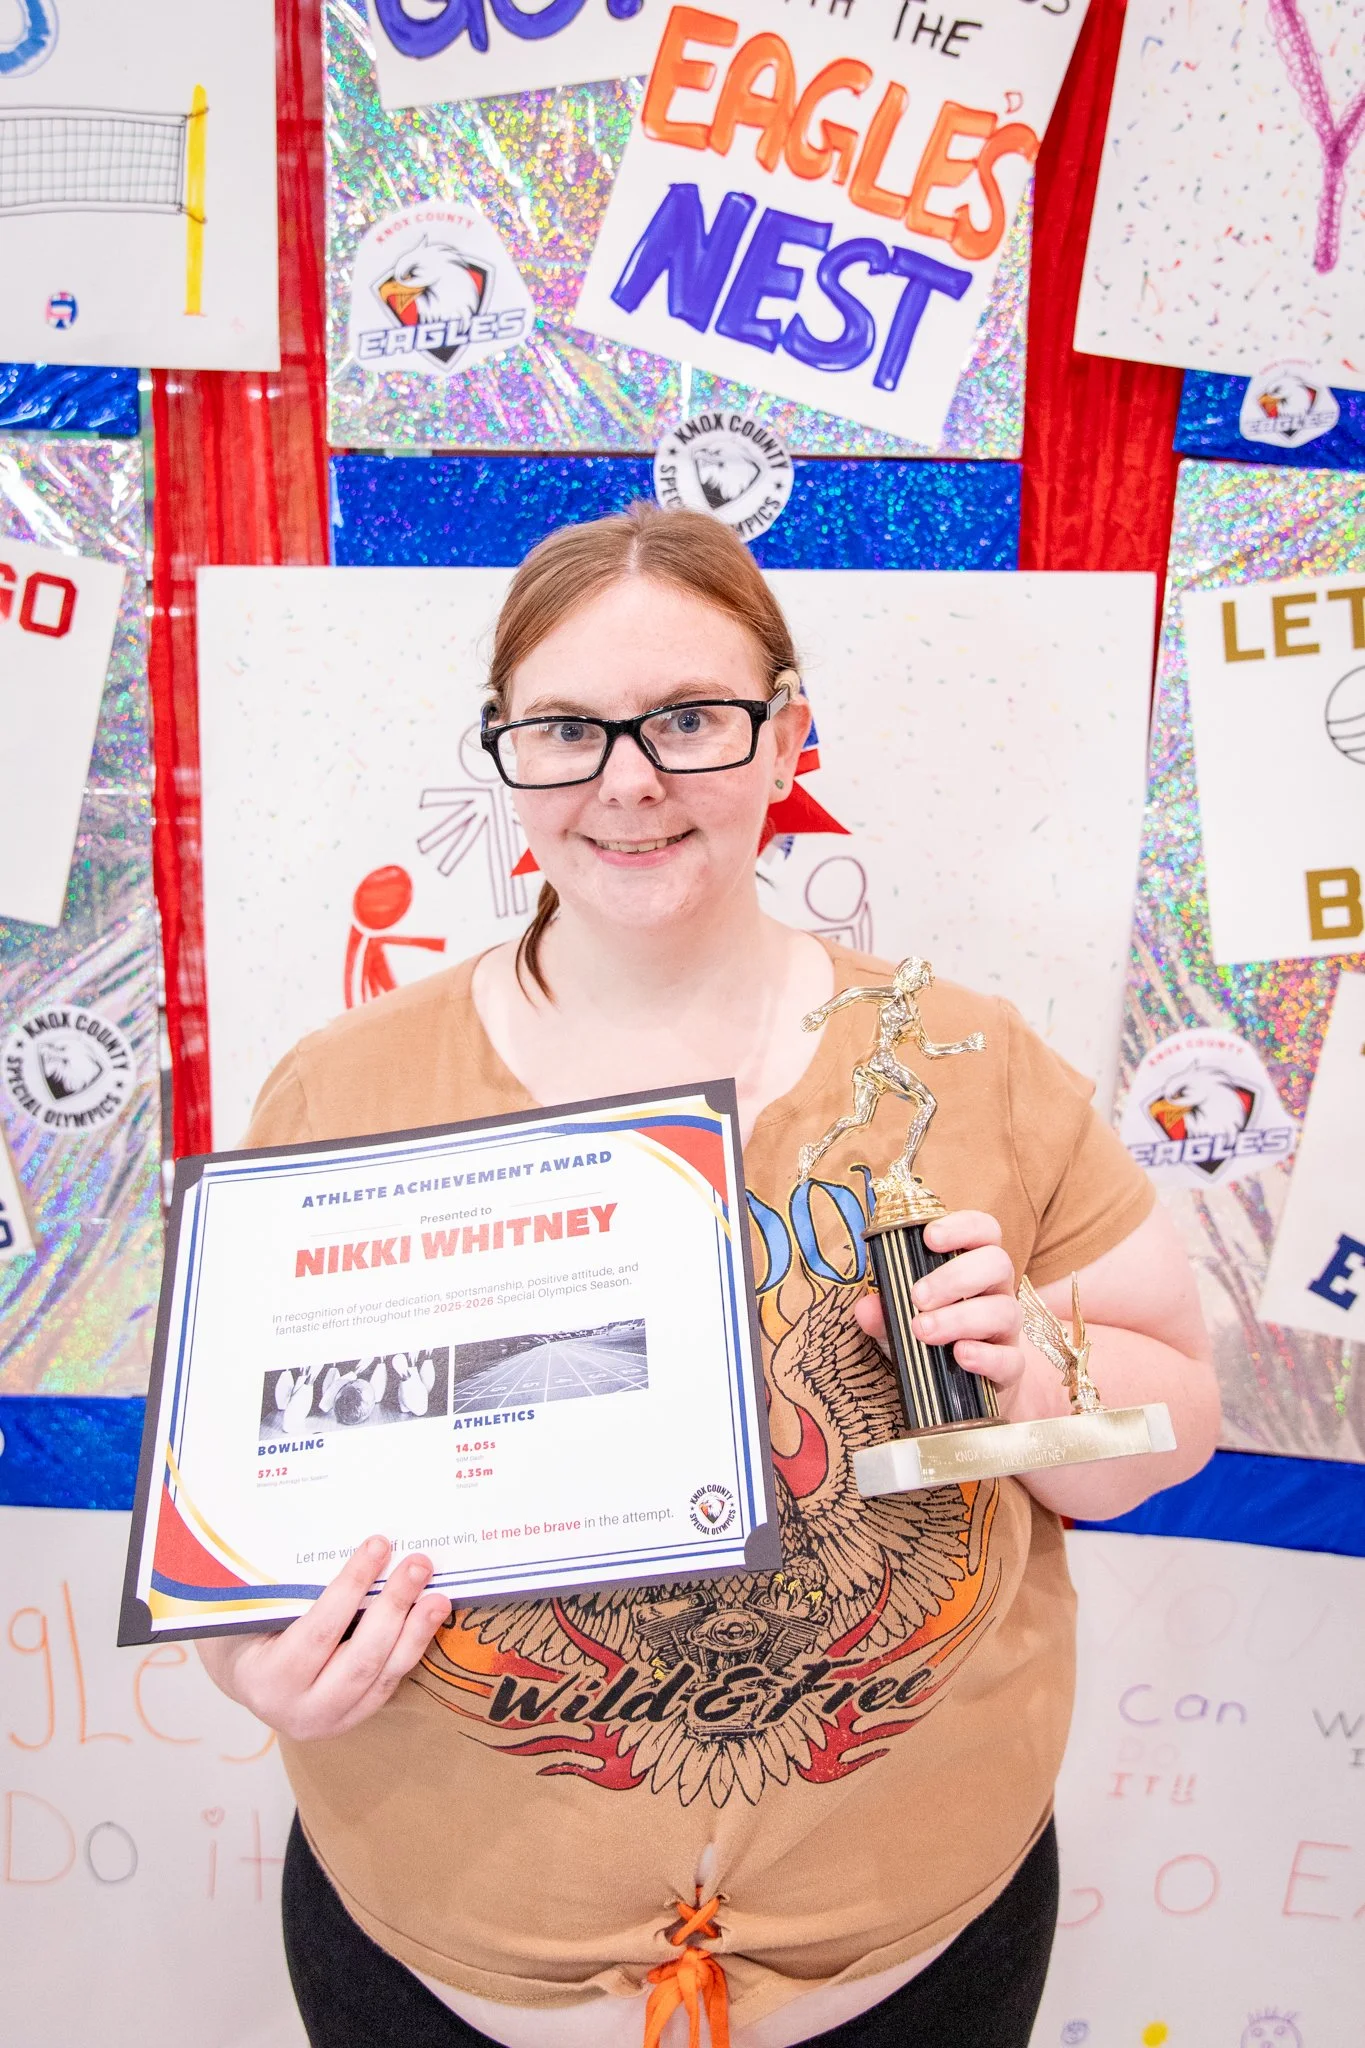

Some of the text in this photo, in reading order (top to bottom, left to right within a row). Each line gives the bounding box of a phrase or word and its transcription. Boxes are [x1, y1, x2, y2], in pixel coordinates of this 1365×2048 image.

[892, 0, 983, 58] THE
[415, 212, 475, 230] COUNTY
[610, 183, 973, 392] NEST
[357, 308, 527, 361] EAGLES
[674, 412, 790, 471] KNOX COUNTY
[660, 464, 686, 509] SPEC
[23, 1012, 130, 1070] KNOX COUNTY
[7, 1055, 122, 1128] SPECIAL OLYMPICS
[1127, 1127, 1293, 1168] EAGLES
[302, 1150, 613, 1209] ATHLETE ACHIEVEMENT AWARD
[295, 1202, 619, 1279] NIKKI WHITNEY
[420, 1206, 493, 1225] Presented to
[272, 1261, 640, 1326] In recognition of your dedication, sportsmanship, positive attitude, and
[275, 1276, 633, 1336] fantastic effort throughout the 2025-2026 Special Olympics Season.
[453, 1409, 536, 1430] ATHLETICS
[257, 1438, 325, 1456] BOWLING
[257, 1466, 288, 1479] 57.12
[455, 1440, 497, 1453] 14.05s
[455, 1467, 494, 1480] 4.35m
[690, 1484, 734, 1505] KNOX COUNTY
[296, 1552, 316, 1565] Let
[318, 1550, 337, 1562] me
[390, 1539, 398, 1552] if
[407, 1534, 451, 1551] cannot
[453, 1530, 478, 1544] win,
[481, 1528, 499, 1541] let
[501, 1526, 522, 1539] me
[524, 1523, 541, 1536] be
[543, 1519, 582, 1534] brave
[584, 1516, 596, 1529] in
[599, 1513, 620, 1527] the
[622, 1507, 675, 1525] attempt.
[690, 1509, 736, 1535] SPECIAL OLYMPICS
[487, 1656, 934, 1724] Wild & Free
[1117, 1683, 1249, 1728] Can
[4, 1789, 284, 1903] Do it
